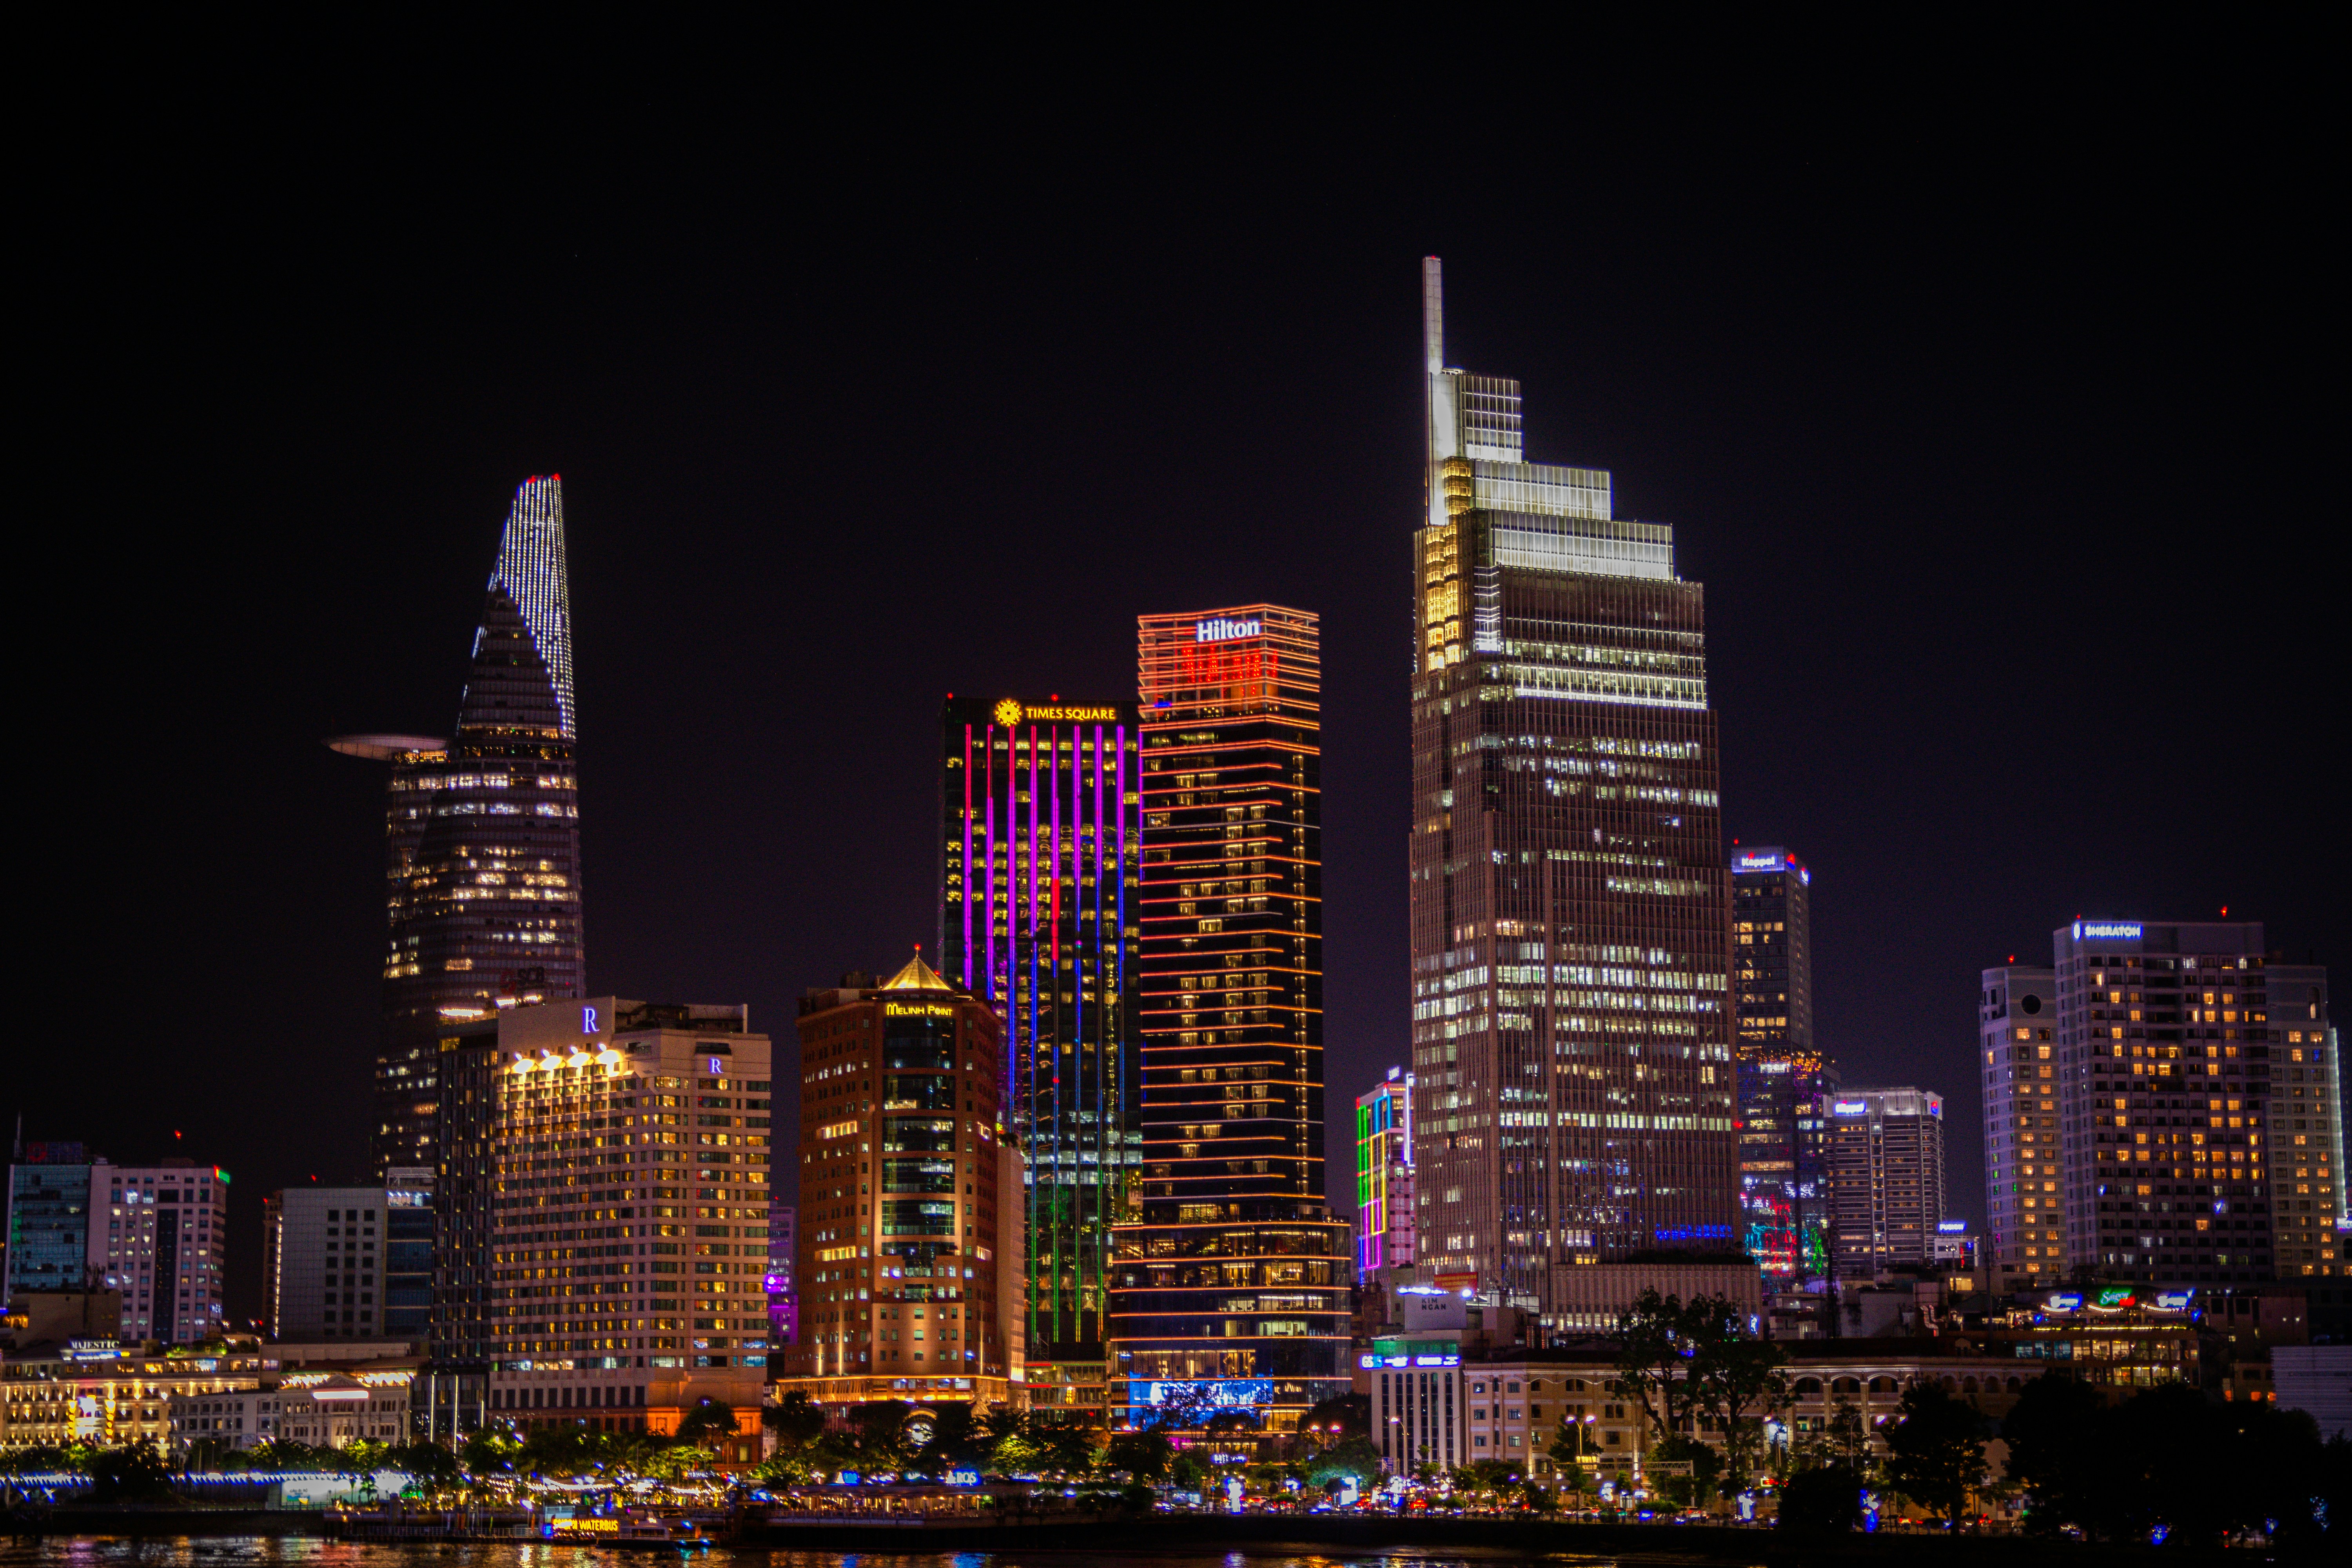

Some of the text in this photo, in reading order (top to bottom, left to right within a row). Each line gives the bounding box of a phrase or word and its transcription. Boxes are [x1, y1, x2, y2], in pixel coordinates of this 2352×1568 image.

[1198, 621, 1259, 642] Hilton
[1026, 709, 1115, 720] TIMES SQUARE
[2085, 926, 2141, 936] SHERATON
[584, 1009, 600, 1033] R
[711, 1059, 724, 1073] R
[71, 1341, 119, 1350] MAJESTIC
[579, 1519, 618, 1531] WATERBUS
